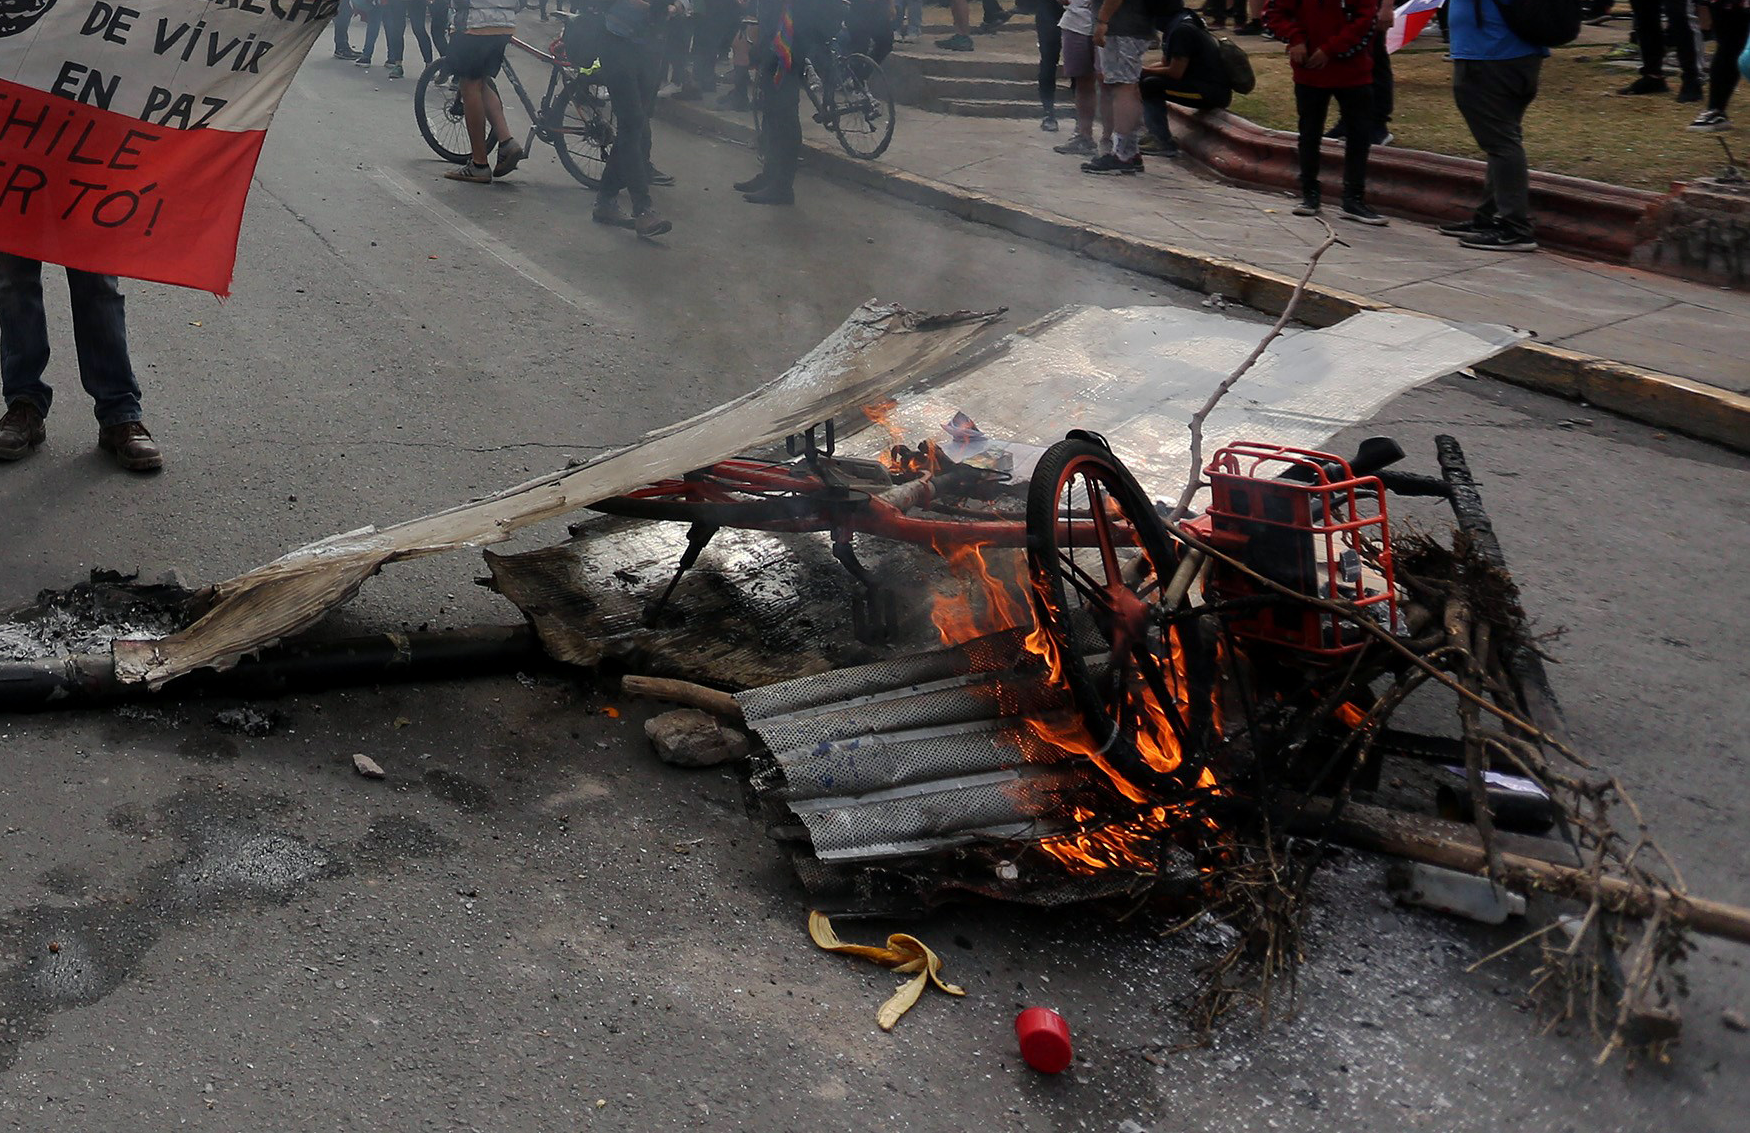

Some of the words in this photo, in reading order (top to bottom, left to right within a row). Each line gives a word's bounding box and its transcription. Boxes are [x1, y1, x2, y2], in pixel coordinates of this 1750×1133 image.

[80, 0, 141, 46] DE
[51, 61, 122, 111] EN
[140, 85, 228, 130] PAZ
